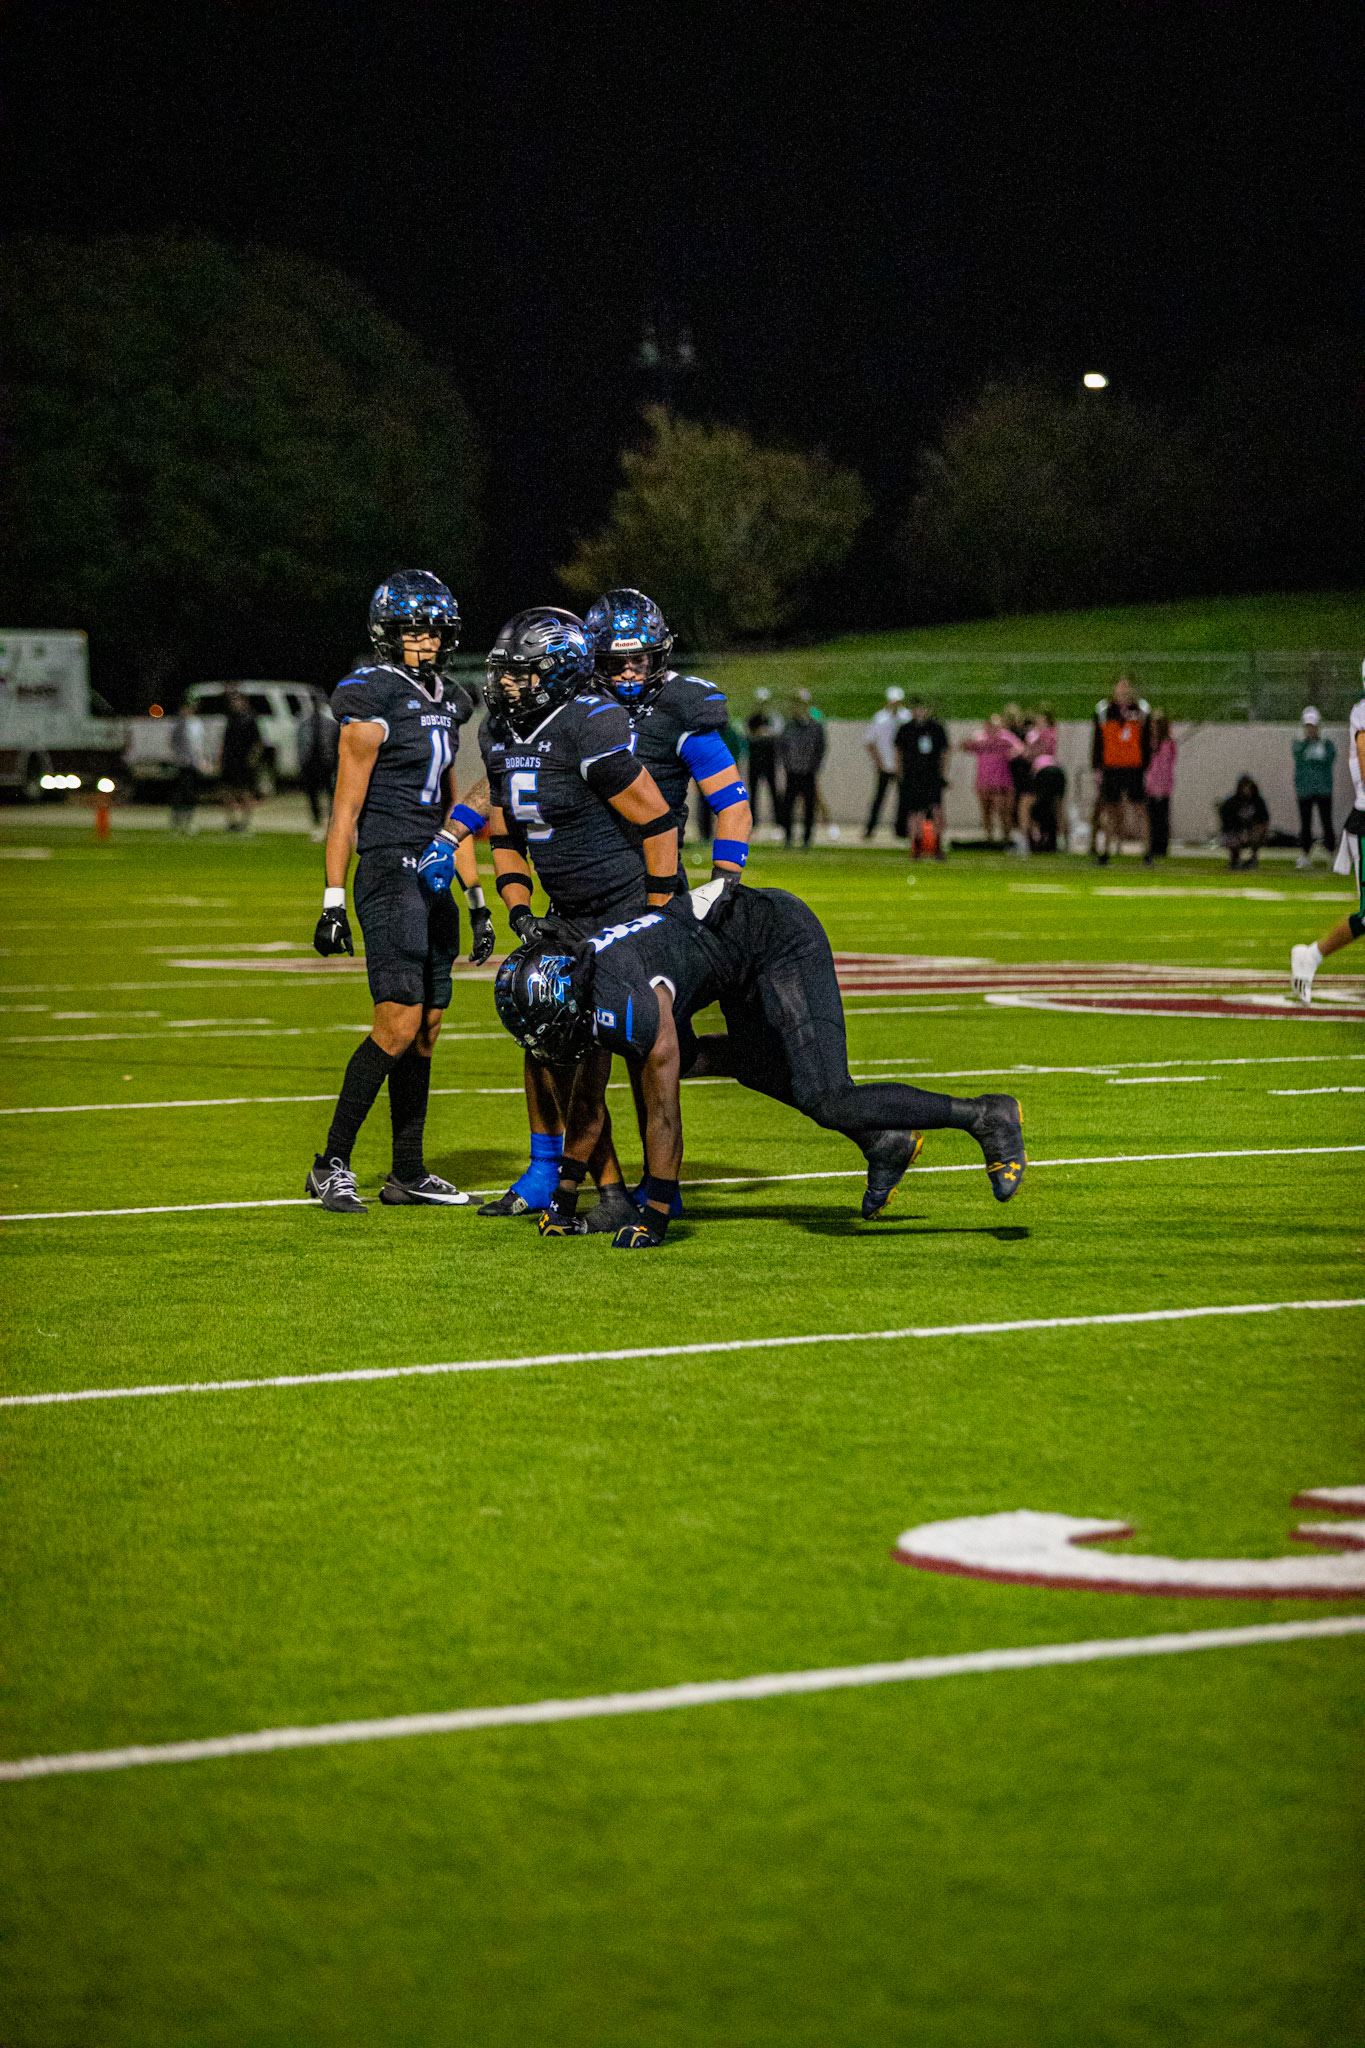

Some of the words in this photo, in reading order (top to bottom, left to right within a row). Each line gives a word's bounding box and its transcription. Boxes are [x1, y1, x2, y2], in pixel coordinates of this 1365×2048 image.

[420, 714, 452, 727] BOBCATS
[504, 756, 542, 769] BOBCATS
[508, 770, 554, 842] 5
